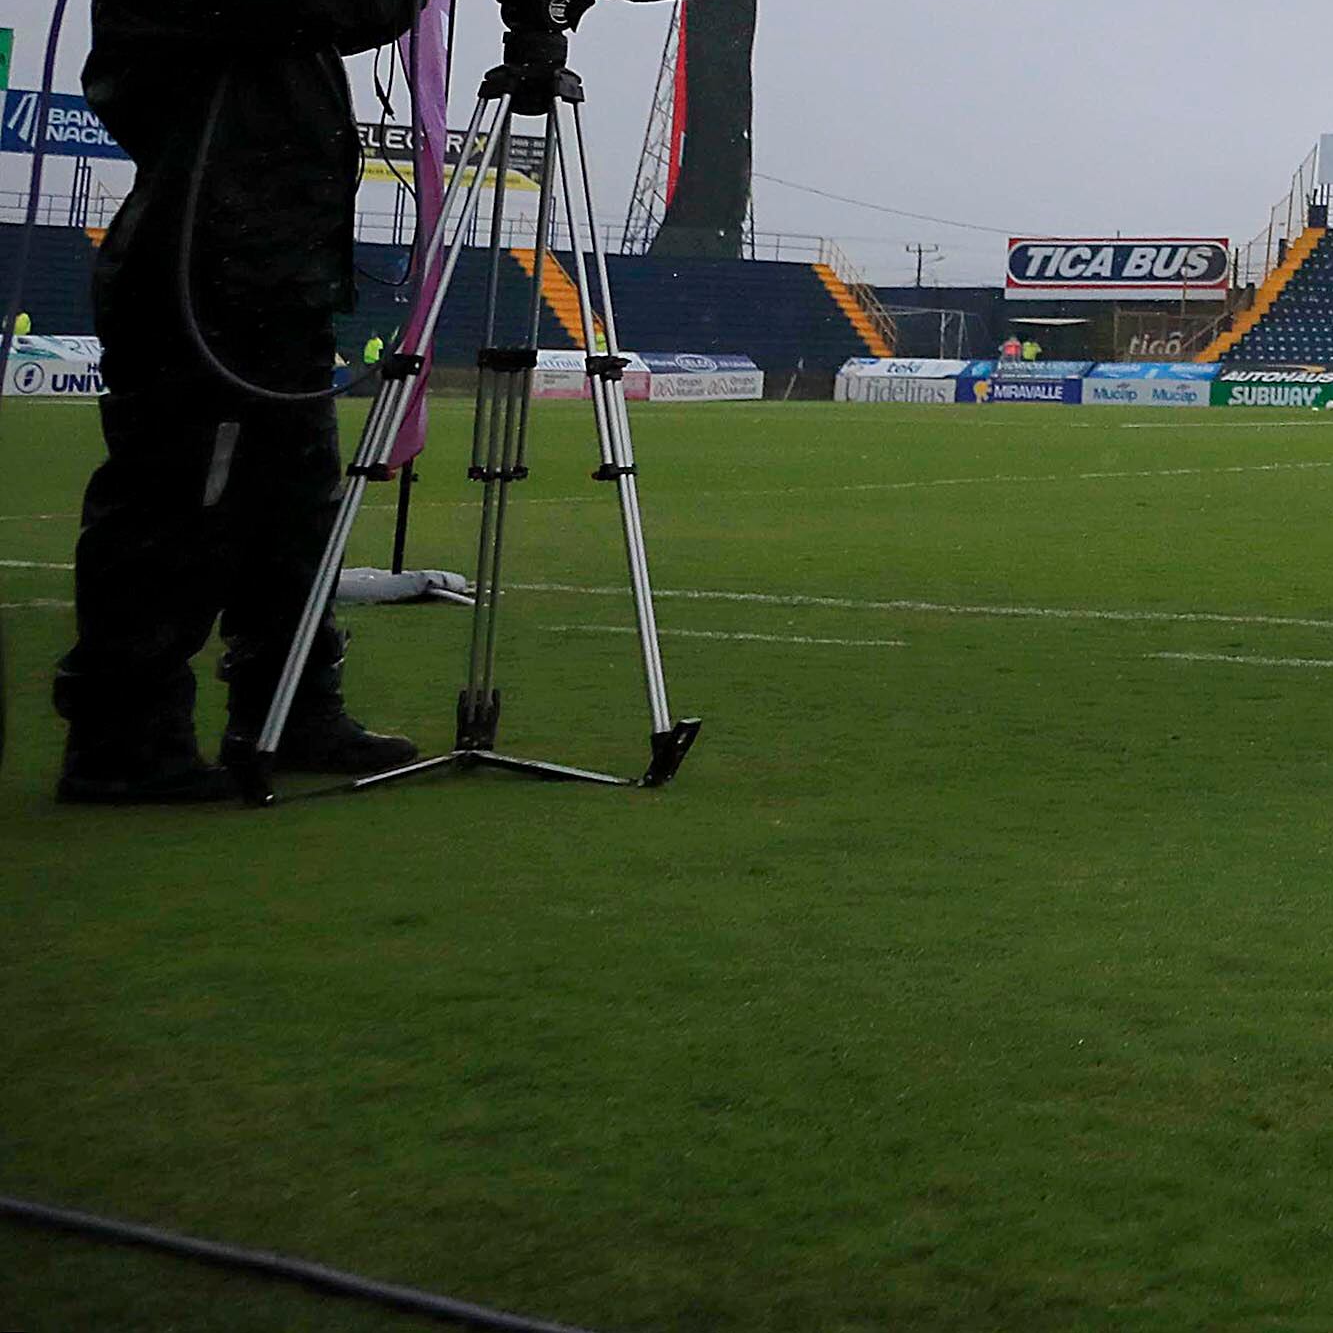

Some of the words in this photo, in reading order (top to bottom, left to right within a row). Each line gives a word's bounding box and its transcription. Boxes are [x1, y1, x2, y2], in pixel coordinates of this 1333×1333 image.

[48, 108, 104, 128] BAN
[1025, 247, 1114, 278] TICA
[1121, 246, 1213, 278] BUS
[994, 382, 1064, 400] MIRAVALLE
[1228, 385, 1321, 406] SUBWAY
